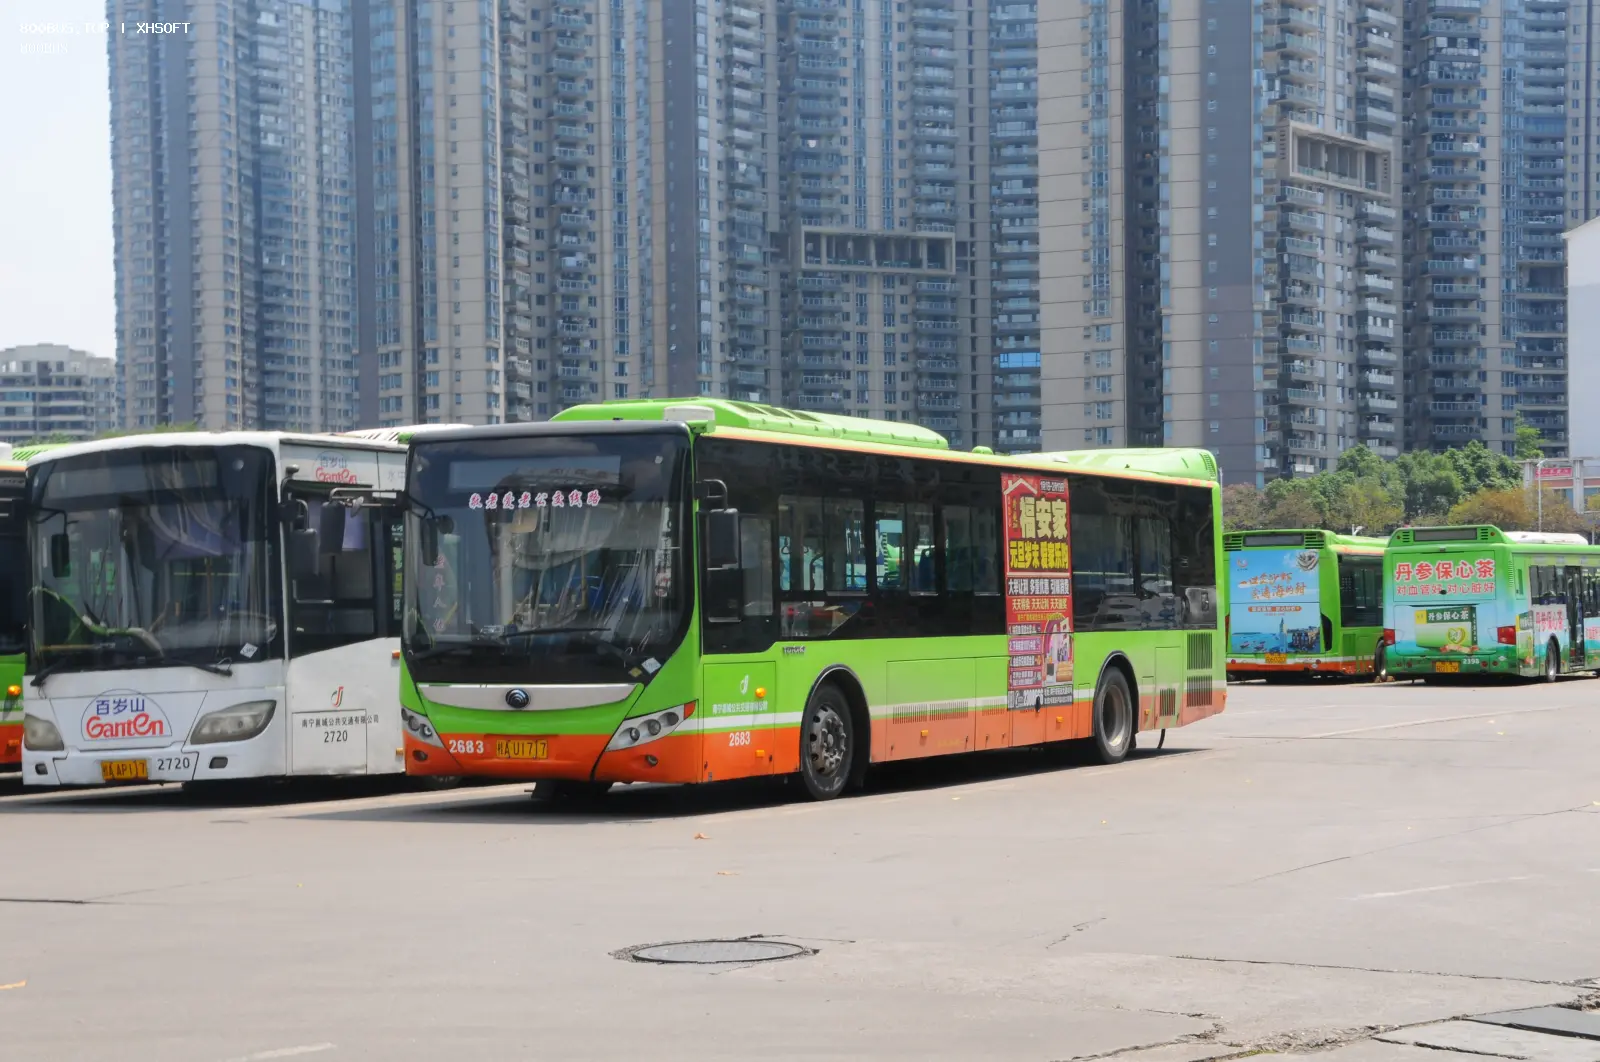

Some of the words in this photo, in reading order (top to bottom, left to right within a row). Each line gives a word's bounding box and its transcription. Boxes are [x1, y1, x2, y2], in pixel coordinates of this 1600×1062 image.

[1395, 558, 1496, 582] 丹参保心茶
[1397, 583, 1443, 596] 对血管好
[1447, 581, 1495, 595] 对心脏好
[1428, 609, 1469, 621] 丹参保心茶
[96, 697, 145, 717] 百岁山
[324, 729, 348, 743] 2720
[729, 731, 751, 747] 2683
[448, 739, 485, 754] 2683
[157, 757, 190, 771] 2720
